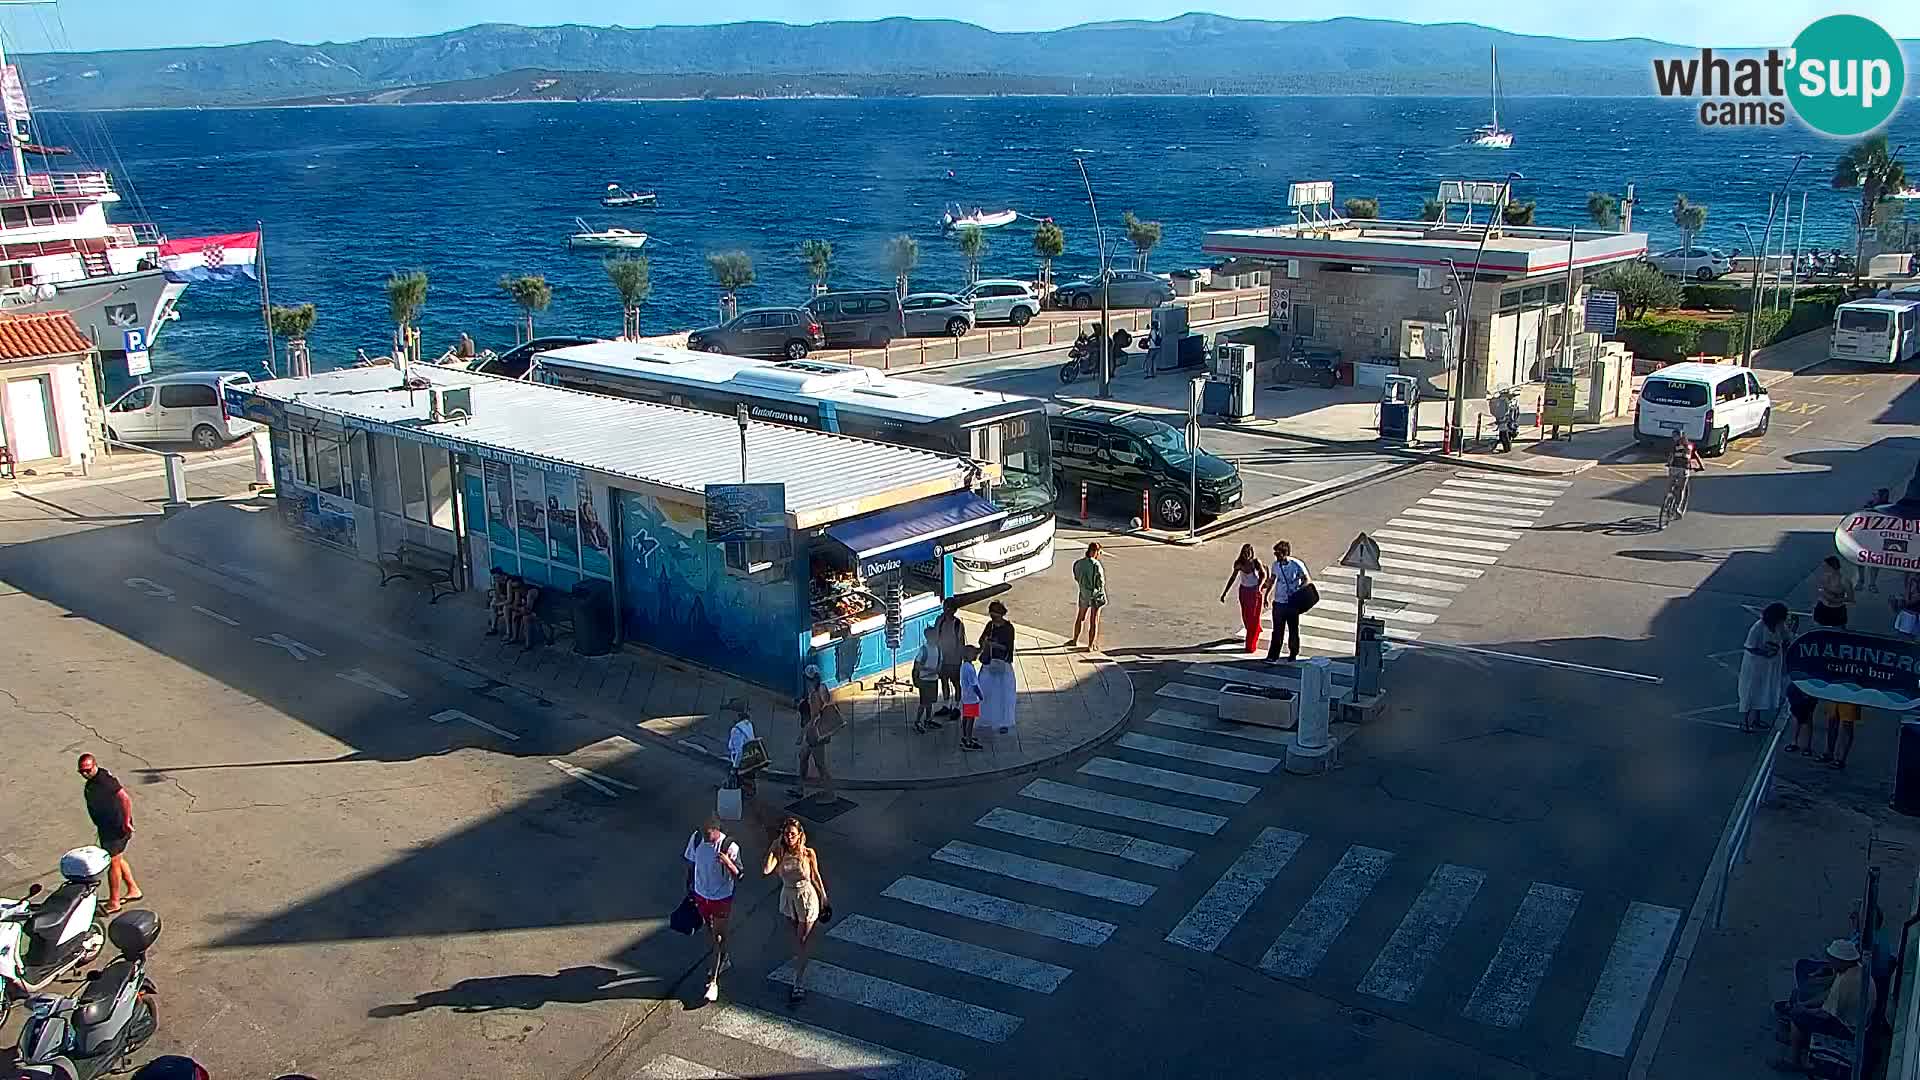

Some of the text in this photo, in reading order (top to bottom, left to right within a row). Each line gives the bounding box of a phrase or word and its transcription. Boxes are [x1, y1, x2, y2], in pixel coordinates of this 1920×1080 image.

[128, 331, 142, 351] P
[477, 446, 492, 459] BUS
[493, 451, 525, 465] STATION
[527, 458, 555, 472] TICKET
[554, 463, 582, 478] OFFICE
[1846, 516, 1920, 534] PIZZE
[999, 540, 1030, 556] IVECO
[1868, 666, 1896, 680] bar
